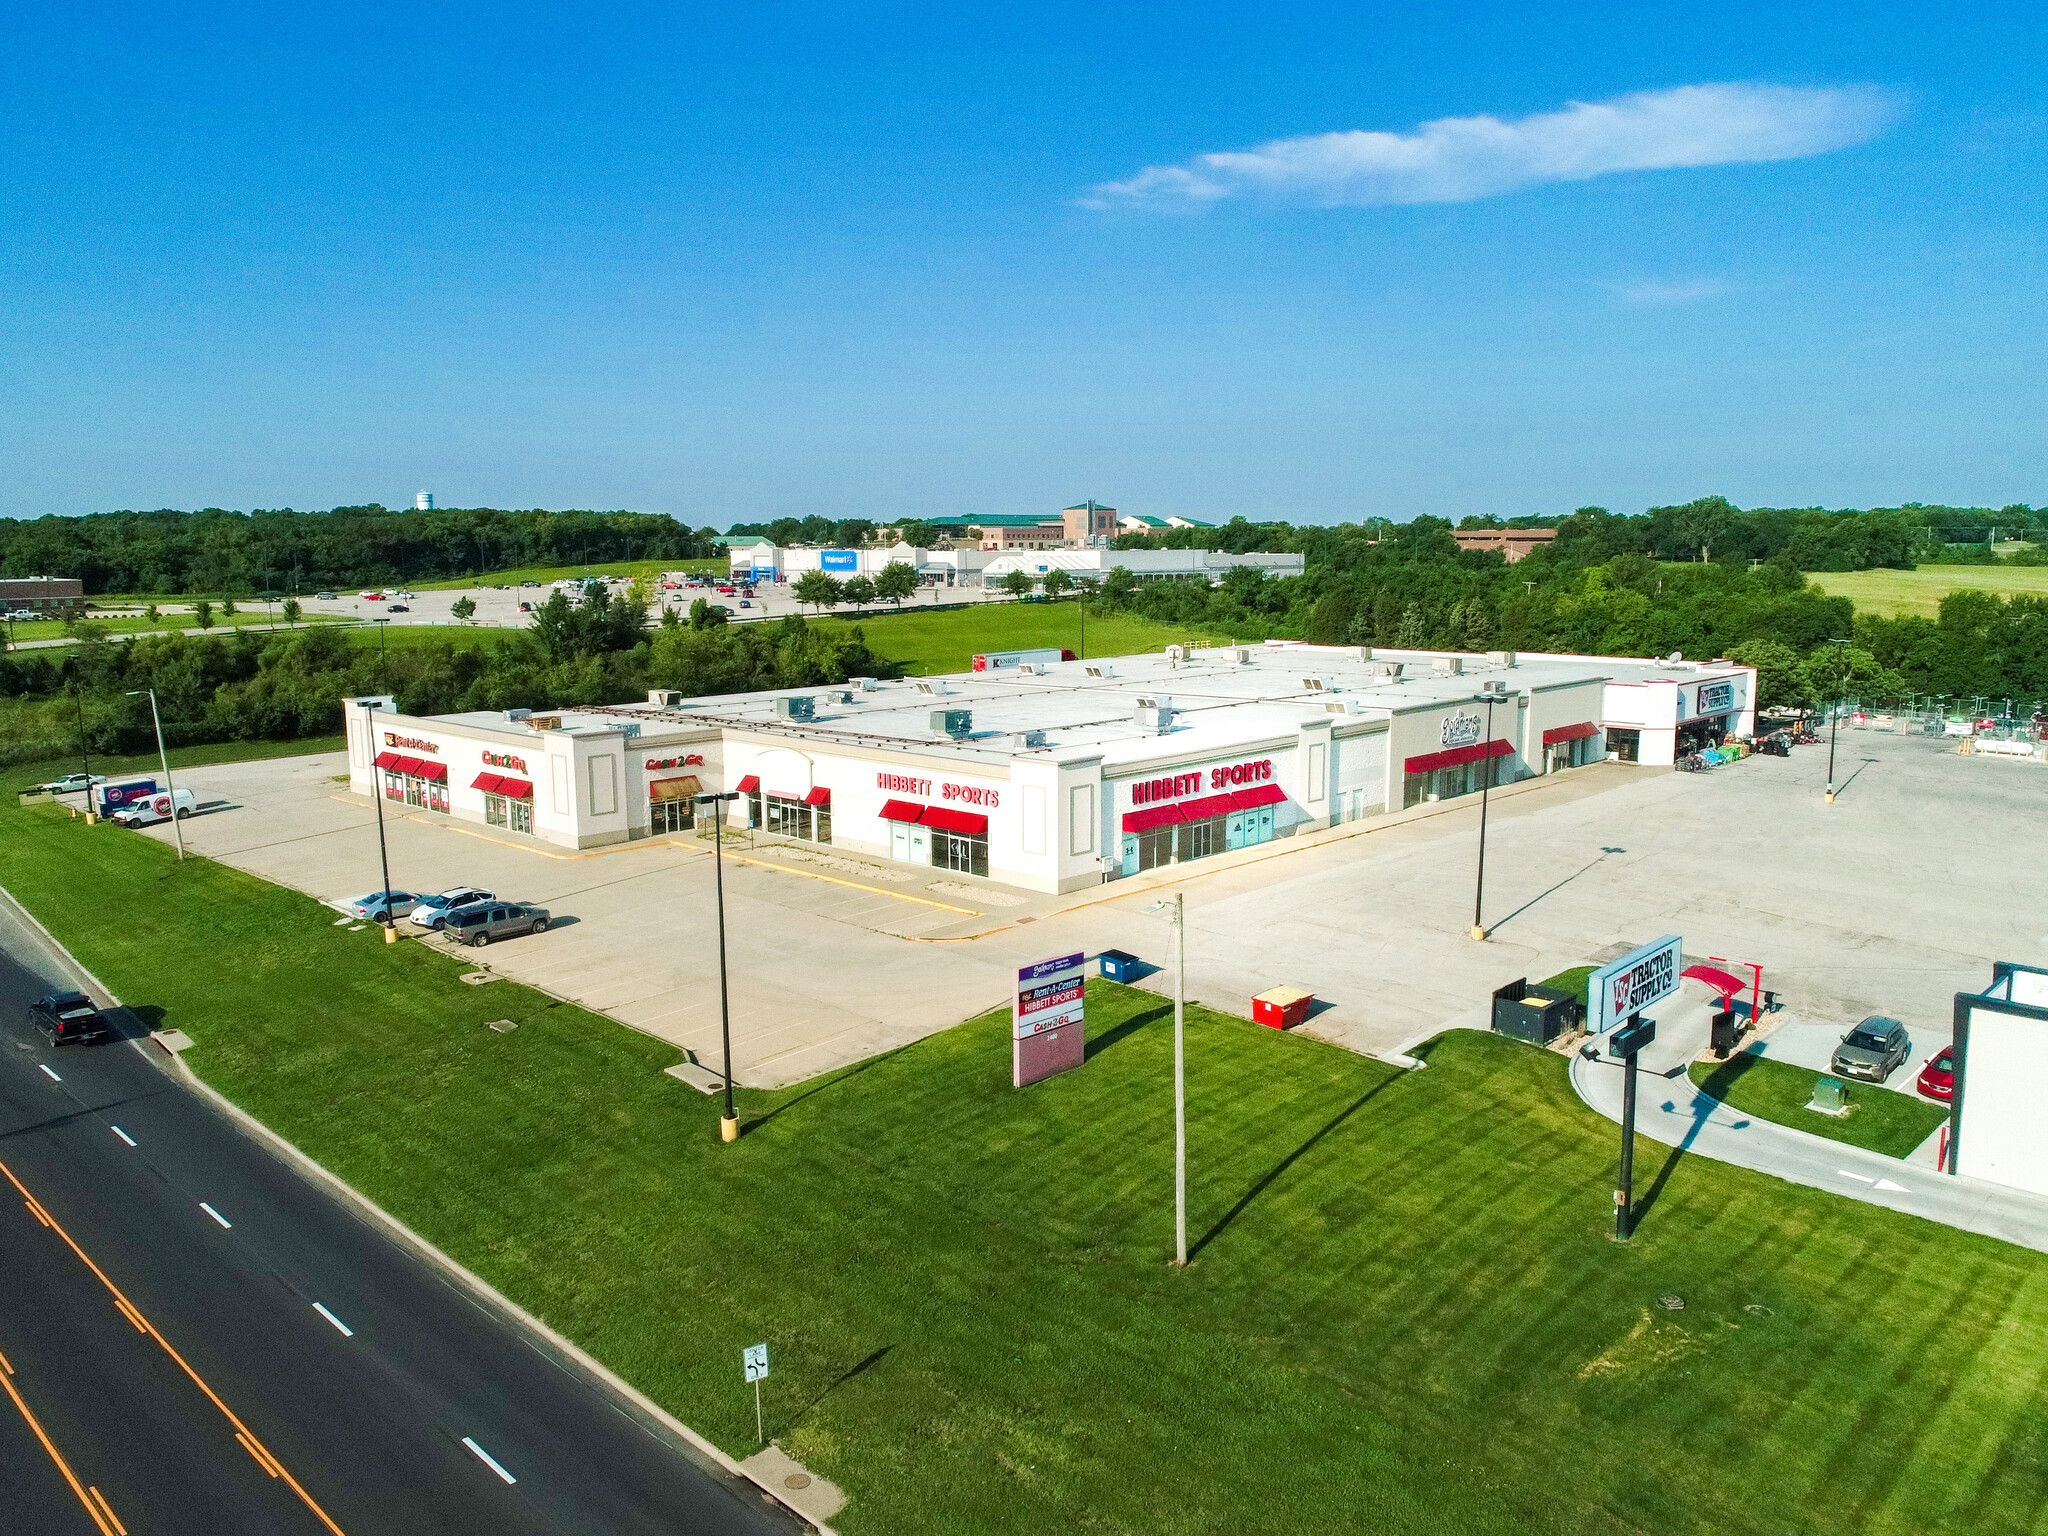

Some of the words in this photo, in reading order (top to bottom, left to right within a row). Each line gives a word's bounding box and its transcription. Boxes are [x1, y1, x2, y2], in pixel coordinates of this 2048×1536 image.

[824, 555, 847, 563] Walmart
[1000, 657, 1021, 665] KNIGHT
[1708, 697, 1725, 708] SUPPLY
[1709, 685, 1730, 698] TRACTOR
[877, 772, 932, 796] HIBBETT
[941, 782, 999, 808] SPORTS
[1132, 771, 1201, 805] HIBBETT
[1211, 759, 1271, 790] SPORTS
[1615, 980, 1629, 1005] TSC
[1631, 949, 1673, 988] TRACTOR
[1024, 997, 1051, 1013] HIBBETT
[1052, 990, 1078, 1004] SPORTS
[1629, 974, 1662, 1010] SUPPLY
